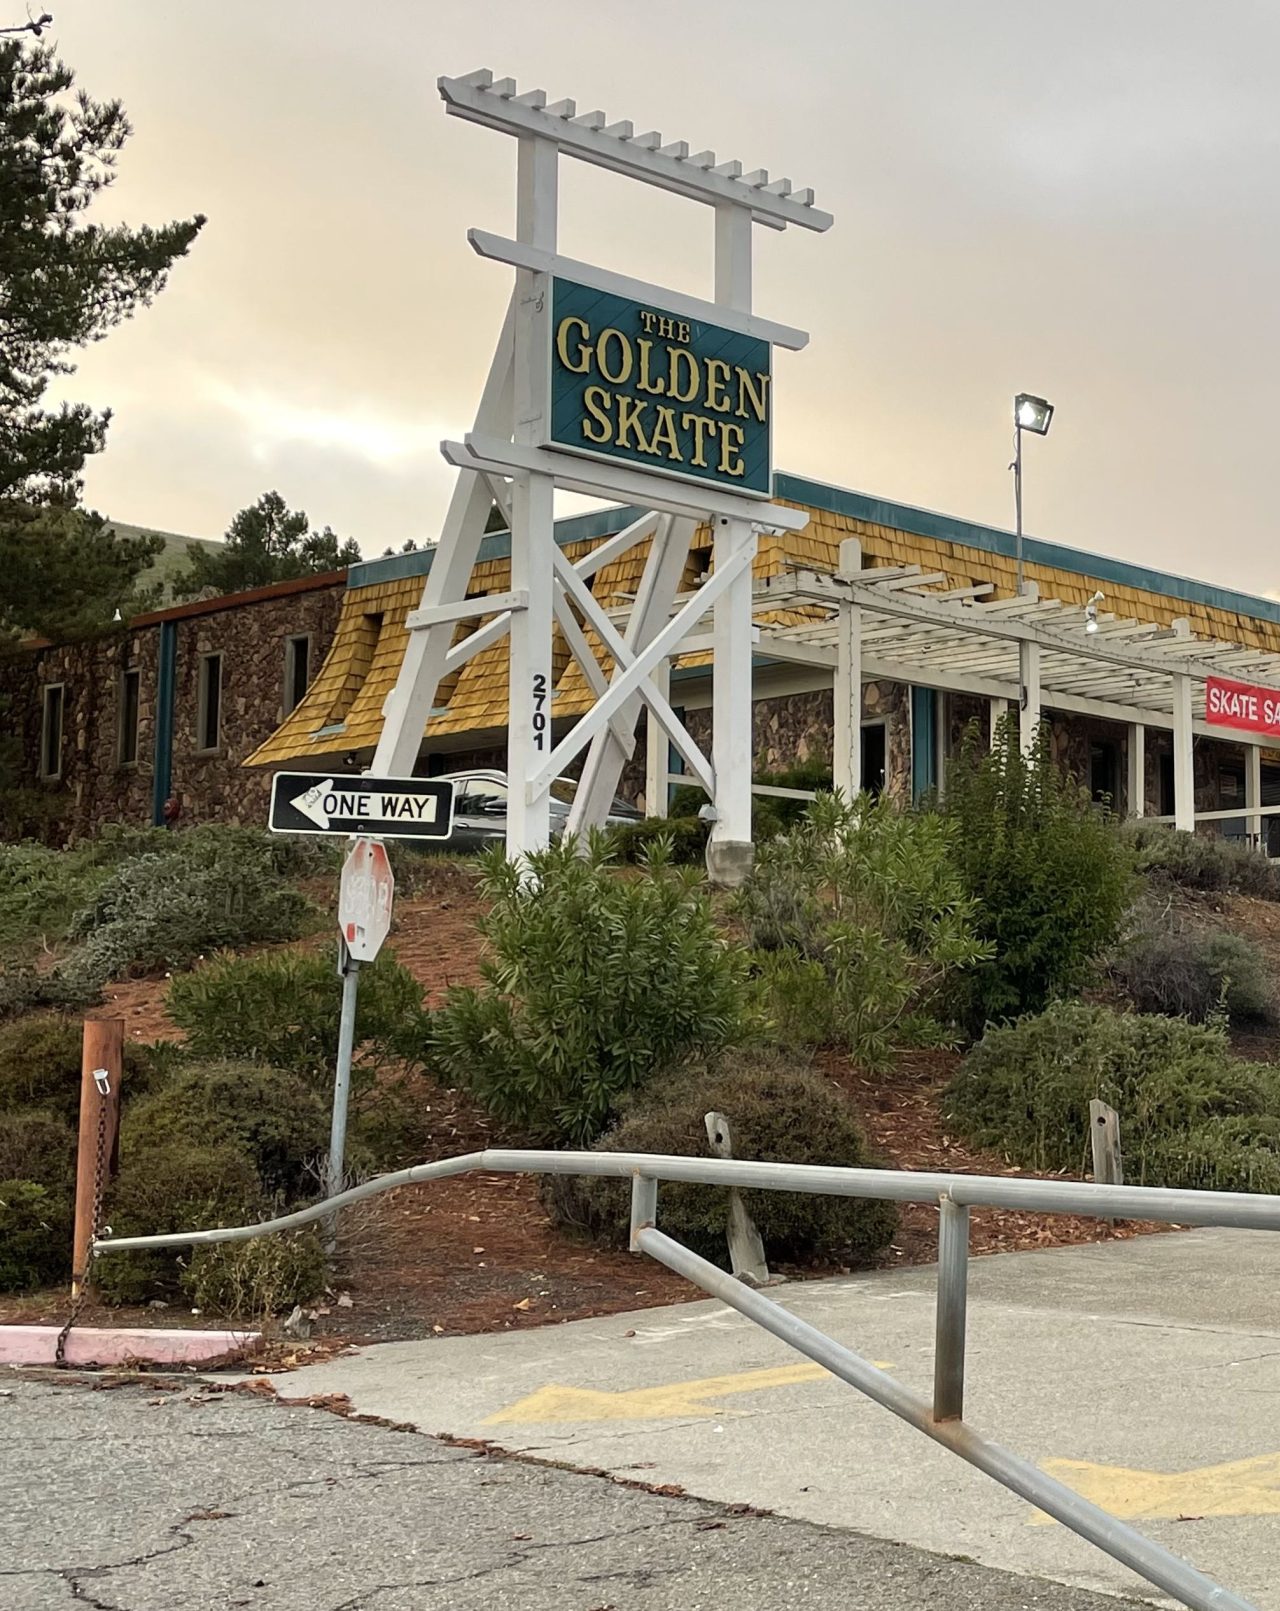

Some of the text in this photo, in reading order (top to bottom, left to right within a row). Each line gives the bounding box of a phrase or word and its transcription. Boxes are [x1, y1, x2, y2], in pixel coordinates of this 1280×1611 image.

[640, 311, 690, 343] THE
[556, 316, 771, 422] GOLDEN
[582, 386, 744, 476] SKATE
[533, 674, 546, 751] 2701
[1209, 687, 1259, 721] SKATE
[323, 793, 370, 817] ONE
[381, 796, 429, 818] WAY
